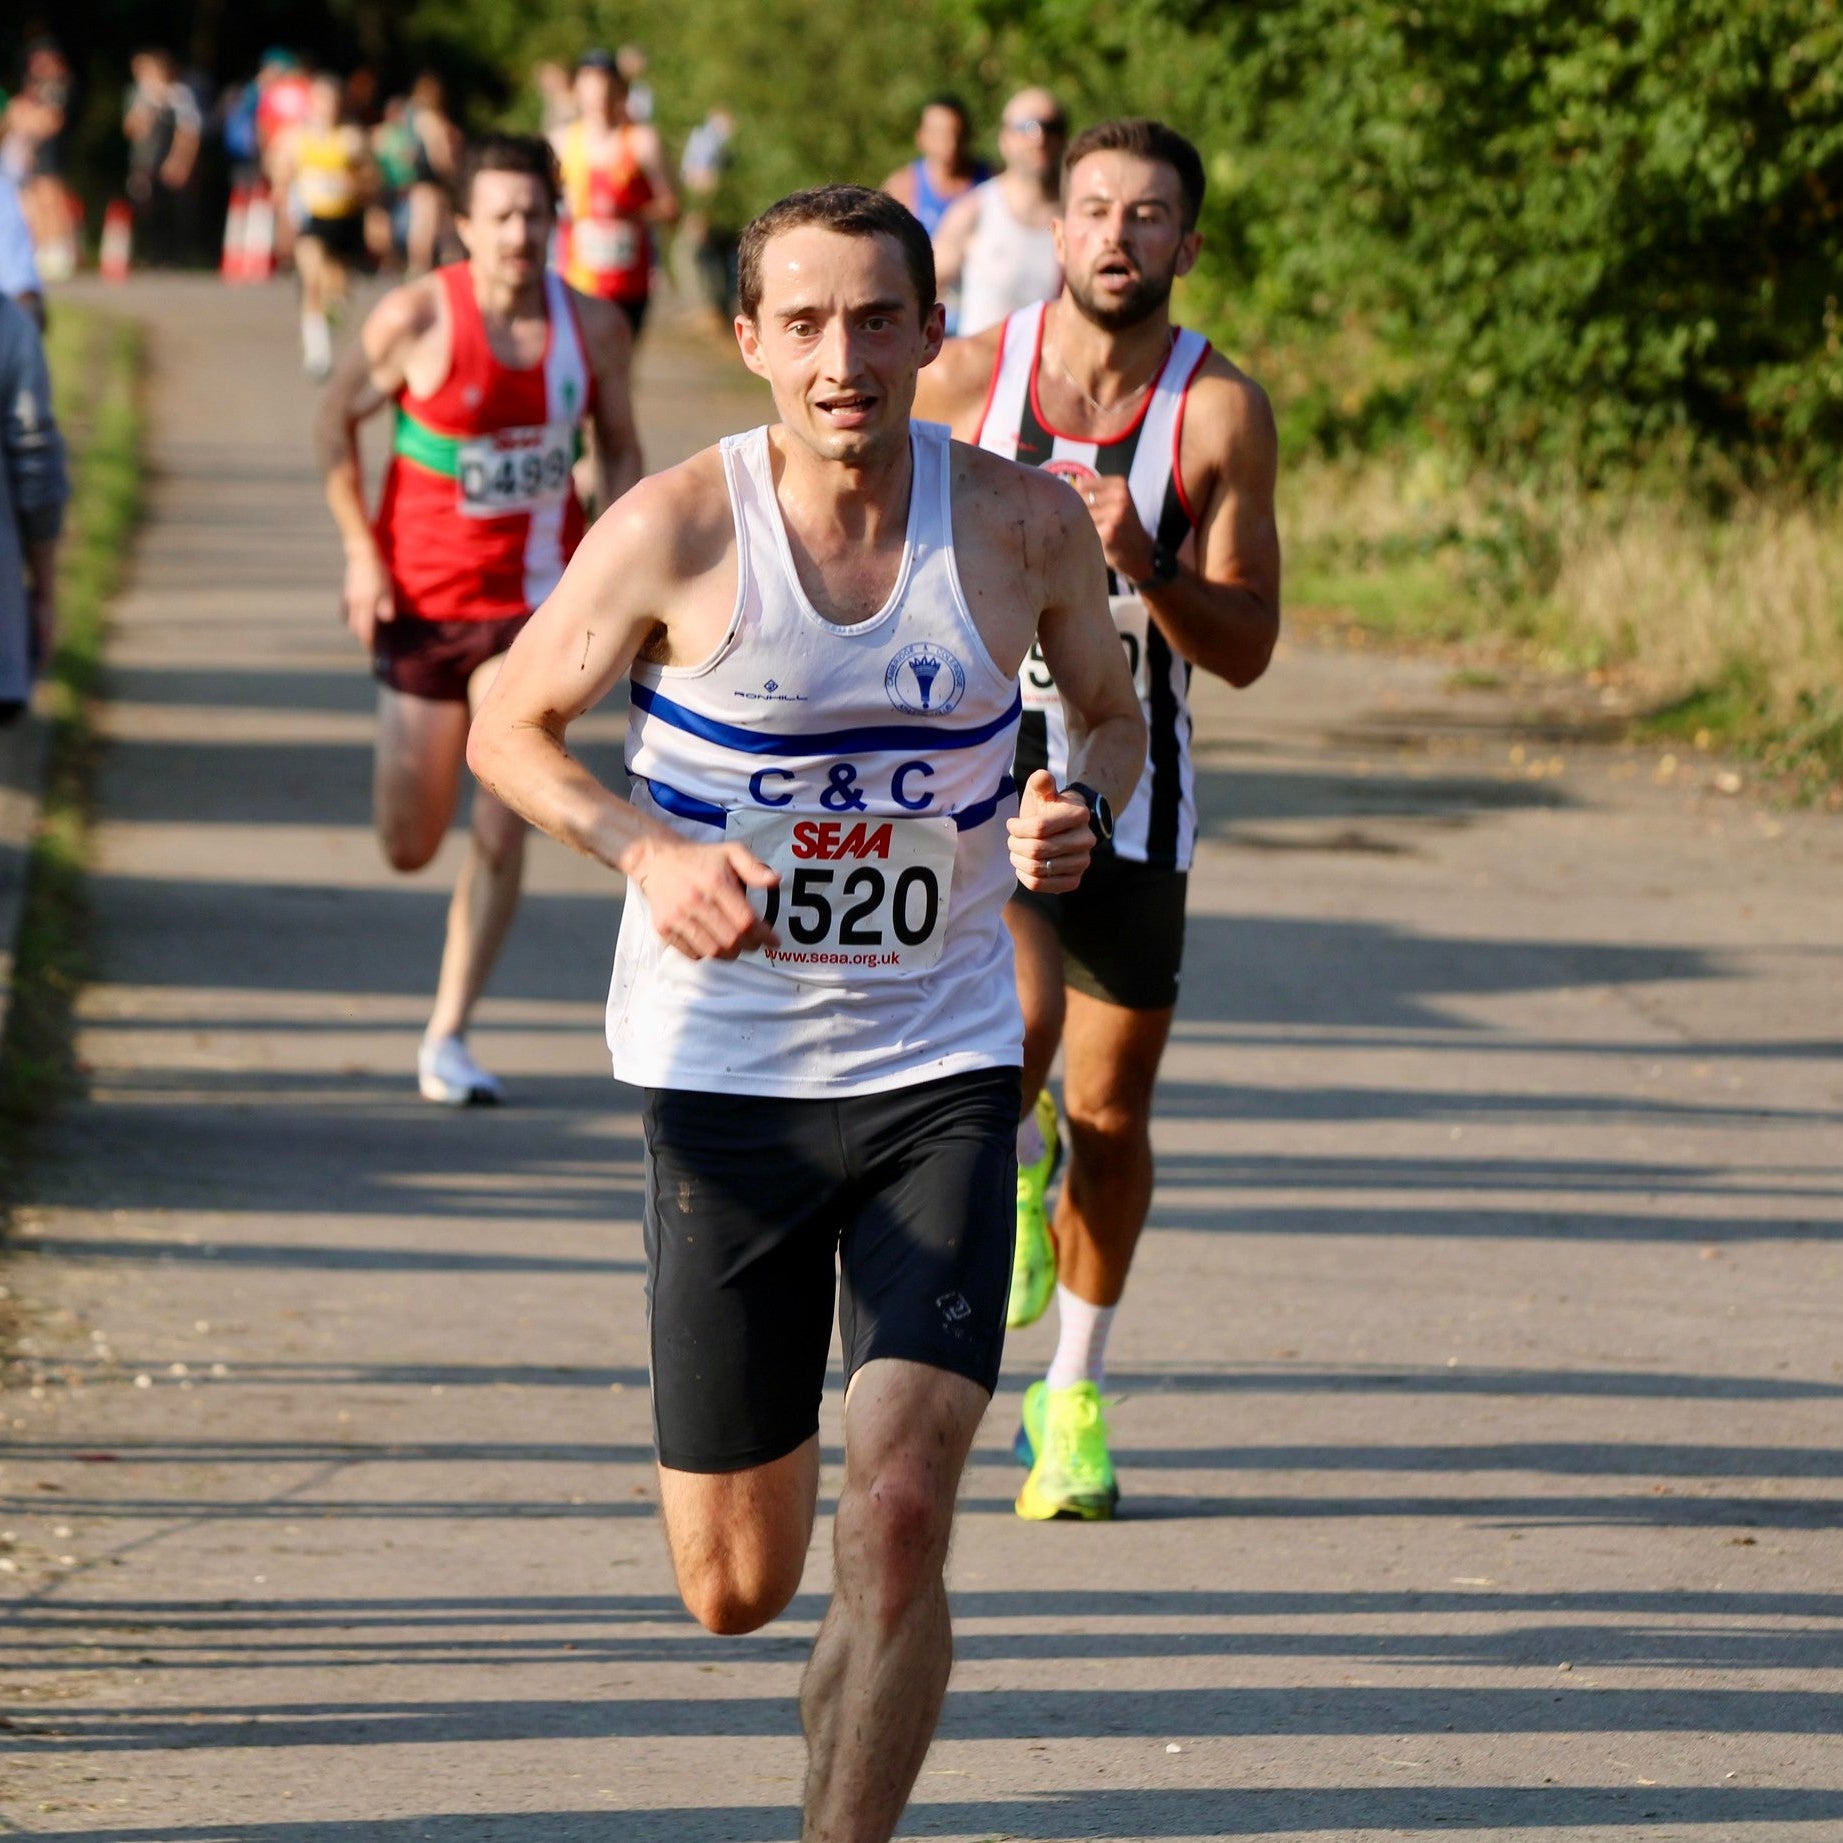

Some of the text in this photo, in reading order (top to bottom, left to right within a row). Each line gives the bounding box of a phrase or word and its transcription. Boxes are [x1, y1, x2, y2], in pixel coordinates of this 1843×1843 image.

[734, 691, 808, 701] RONHILL
[749, 761, 935, 812] C & C
[791, 821, 893, 860] SEAA
[764, 949, 900, 967] www.seaa.org.uk
